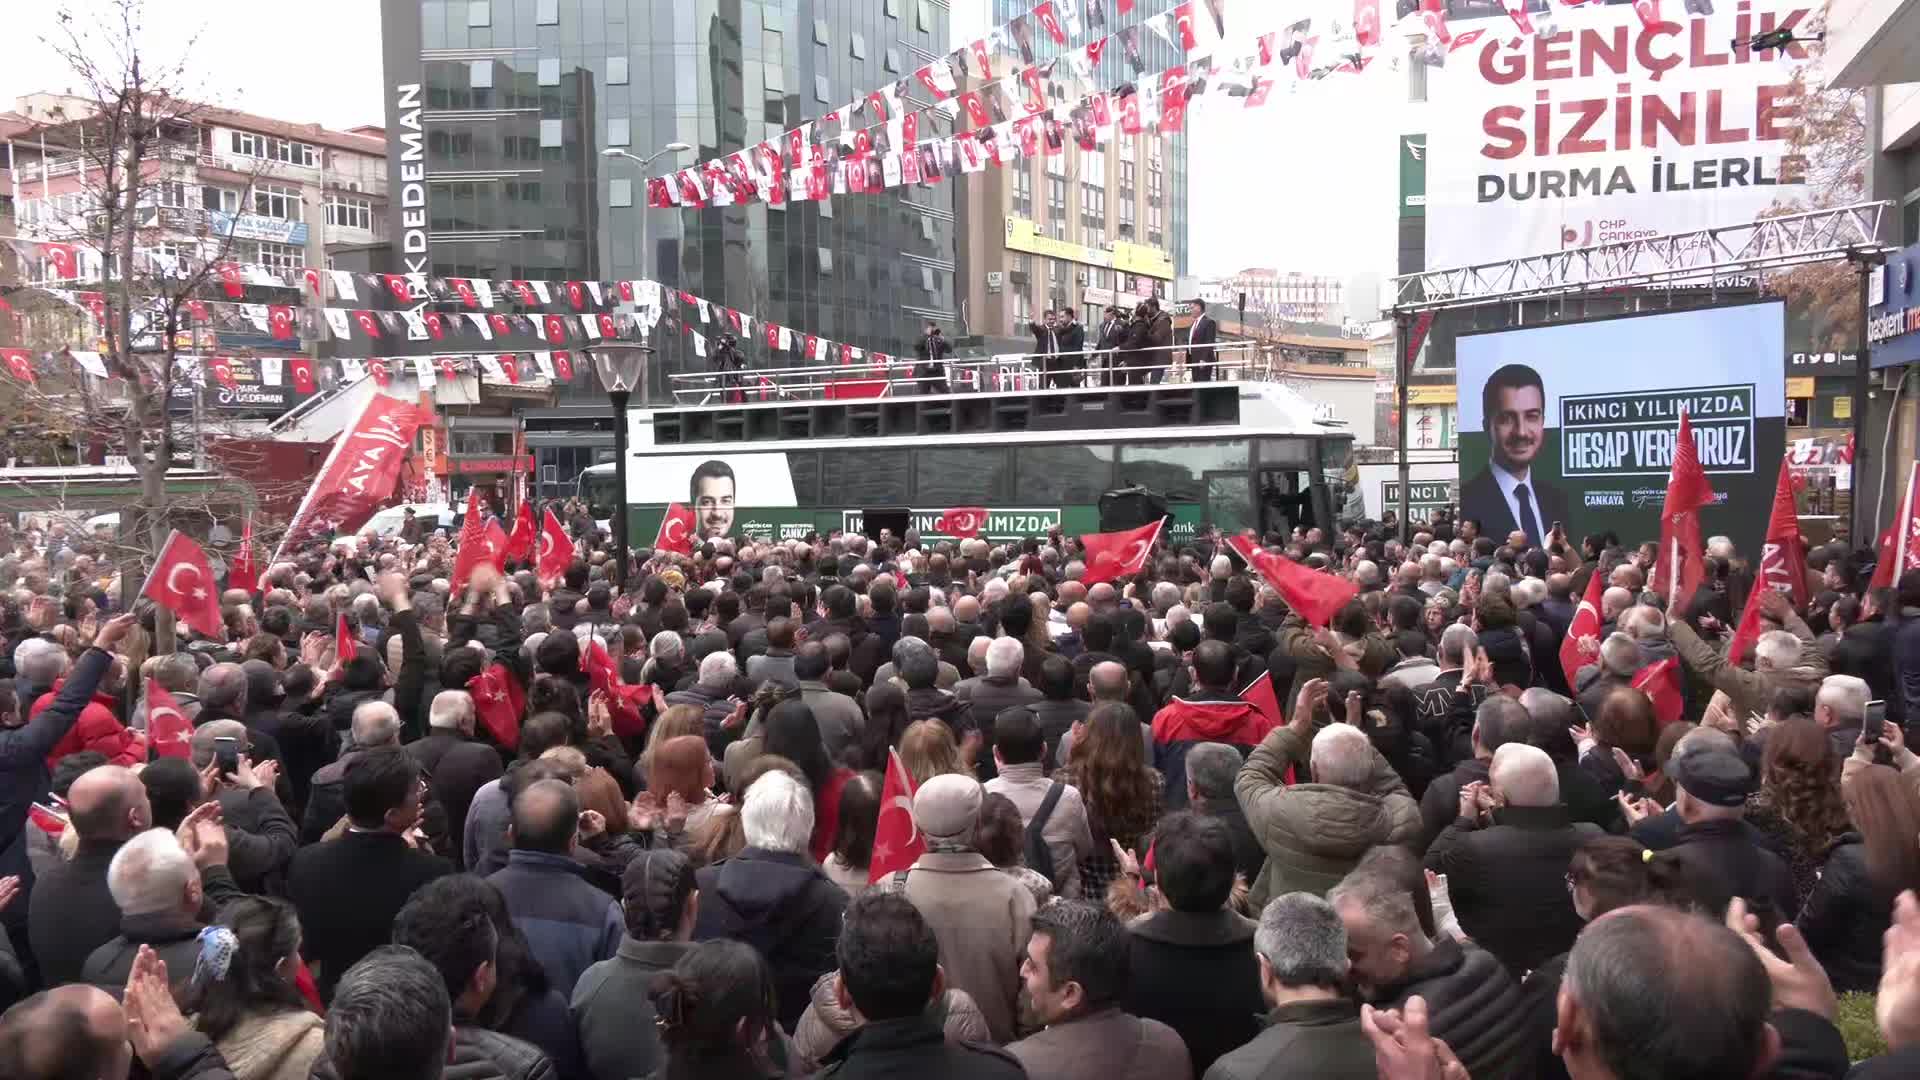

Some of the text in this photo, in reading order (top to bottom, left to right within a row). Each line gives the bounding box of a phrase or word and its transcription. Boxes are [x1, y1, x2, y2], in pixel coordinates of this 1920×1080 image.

[1479, 1, 1811, 84] GENÇLİK
[1479, 82, 1803, 160] SİZİNLE
[1478, 155, 1806, 203] DURMA İLERLE
[1599, 219, 1626, 229] CHP
[1568, 395, 1744, 421] İKİNCİ YILIMIZDA
[1568, 431, 1629, 469] HESAP
[1632, 425, 1746, 468] VERİORUZ
